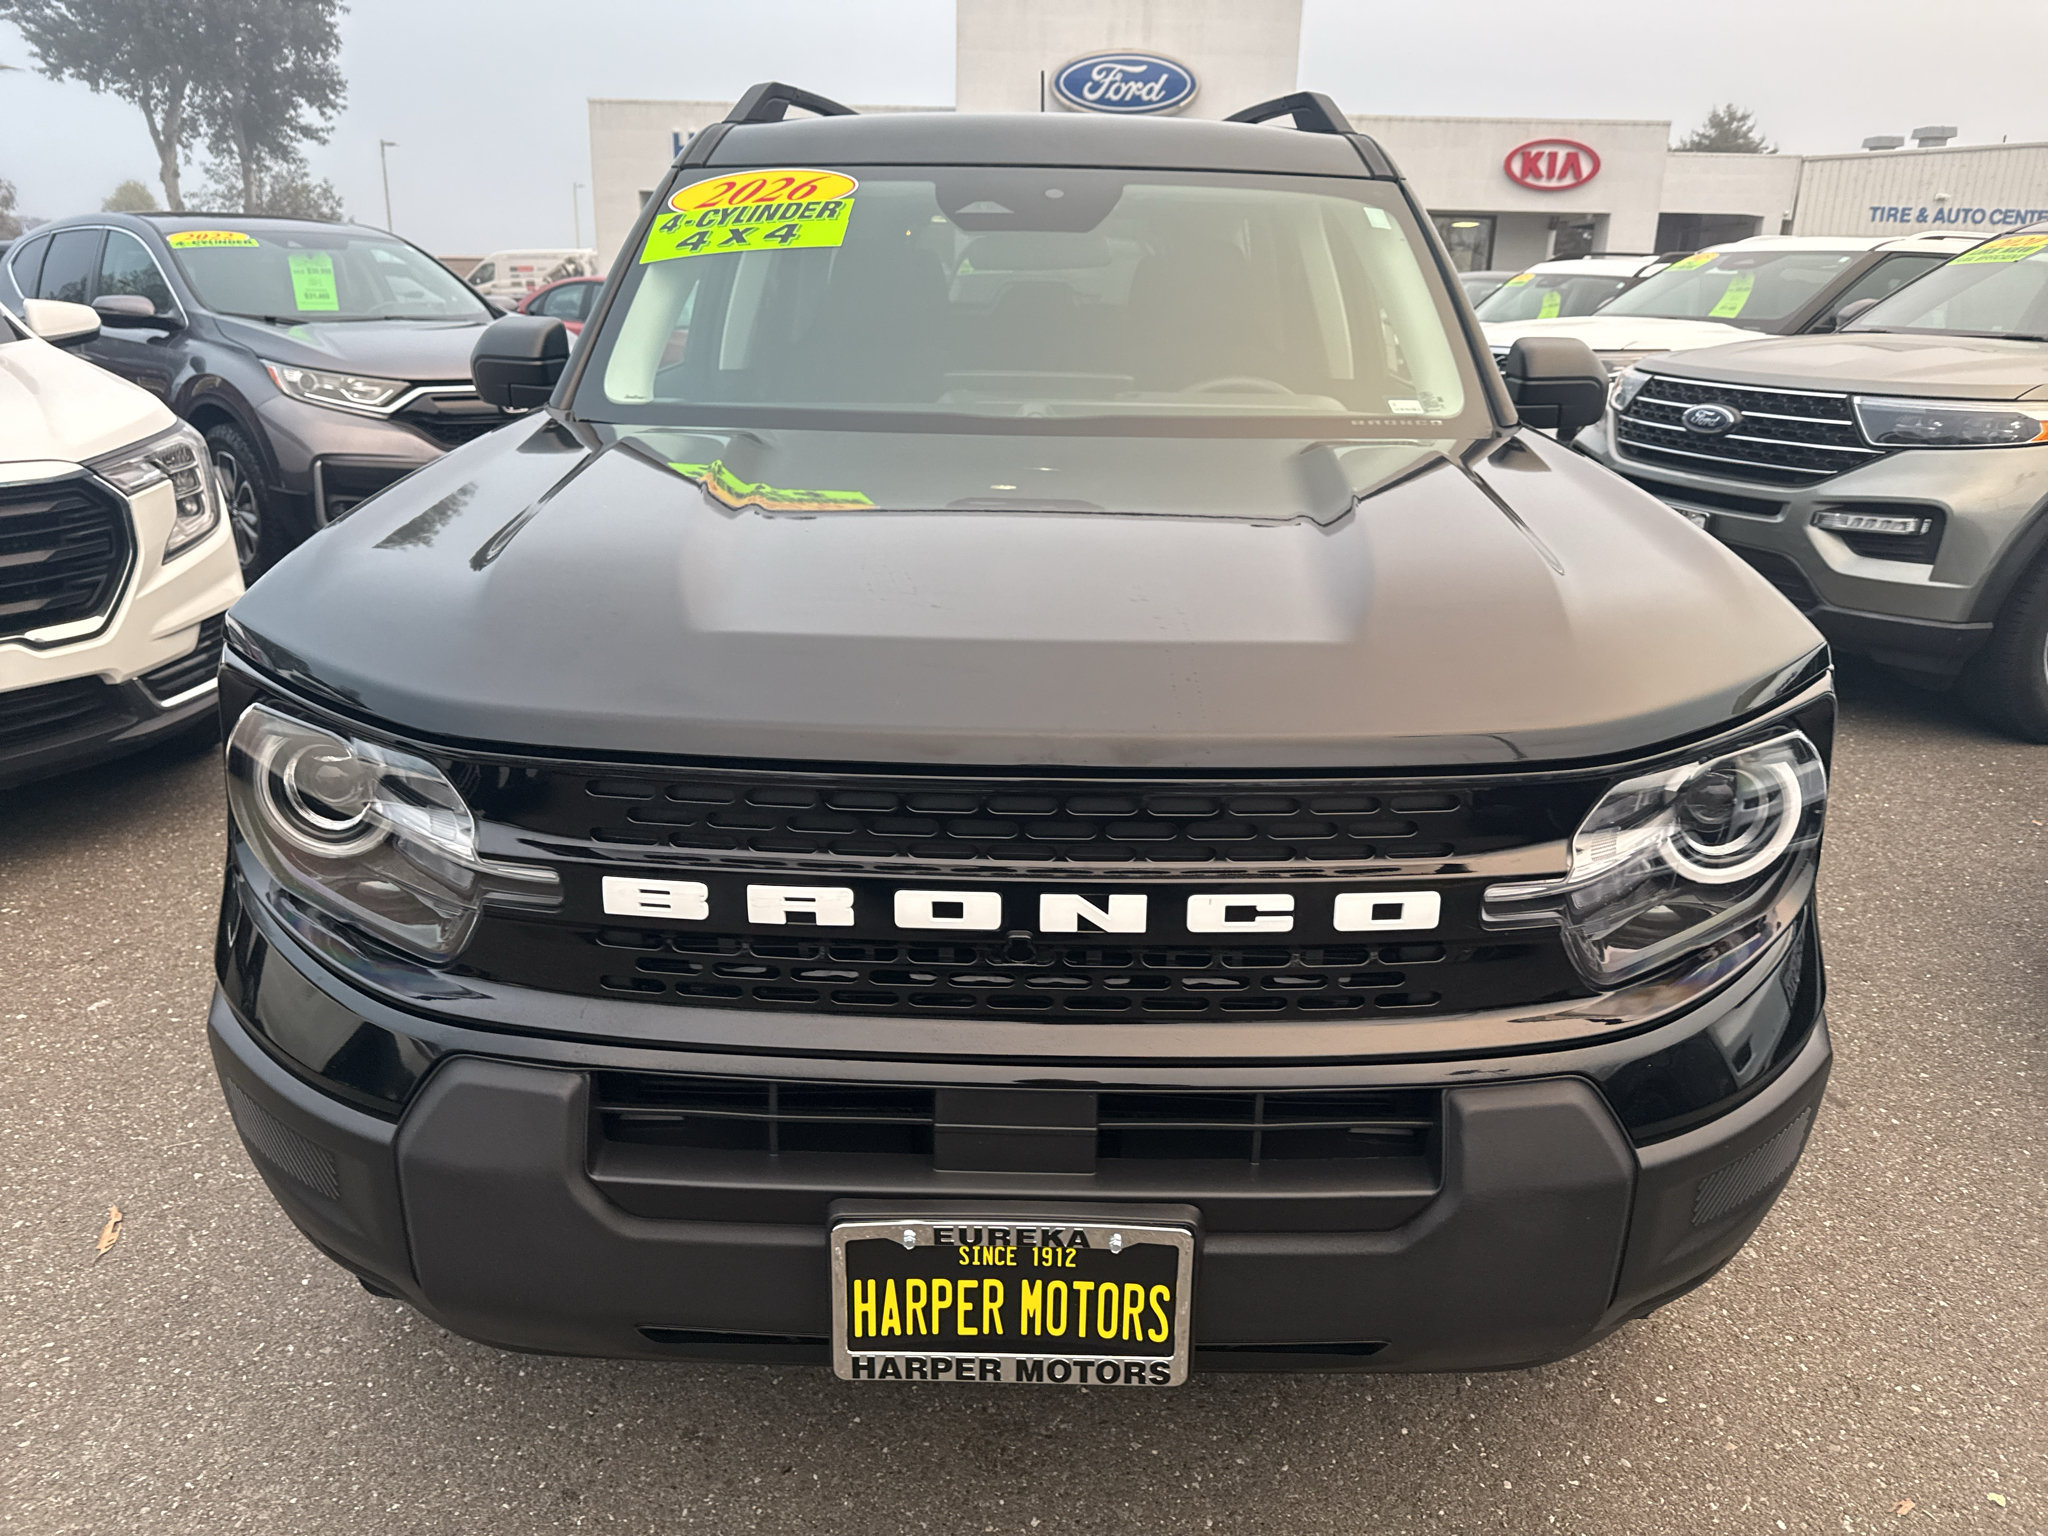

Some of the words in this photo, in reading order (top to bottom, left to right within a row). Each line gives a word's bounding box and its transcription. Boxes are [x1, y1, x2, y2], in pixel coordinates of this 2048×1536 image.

[1082, 63, 1169, 101] Ford
[1521, 151, 1583, 180] KIA
[694, 176, 832, 209] 2026
[659, 201, 846, 233] 4-CYLINDER
[1869, 206, 1912, 223] TIRE
[1916, 207, 1929, 223] &
[1932, 207, 1987, 225] AUTO
[1690, 409, 1721, 427] Ford
[602, 876, 1441, 931] BRONCO
[933, 1227, 1091, 1249] EUREKA
[958, 1246, 1018, 1267] SINCE
[1032, 1247, 1077, 1268] 1912
[853, 1278, 1005, 1338] HARPER
[1020, 1279, 1171, 1343] MOTORS
[852, 1356, 1002, 1382] HARPER
[1015, 1358, 1171, 1385] MOTORS
